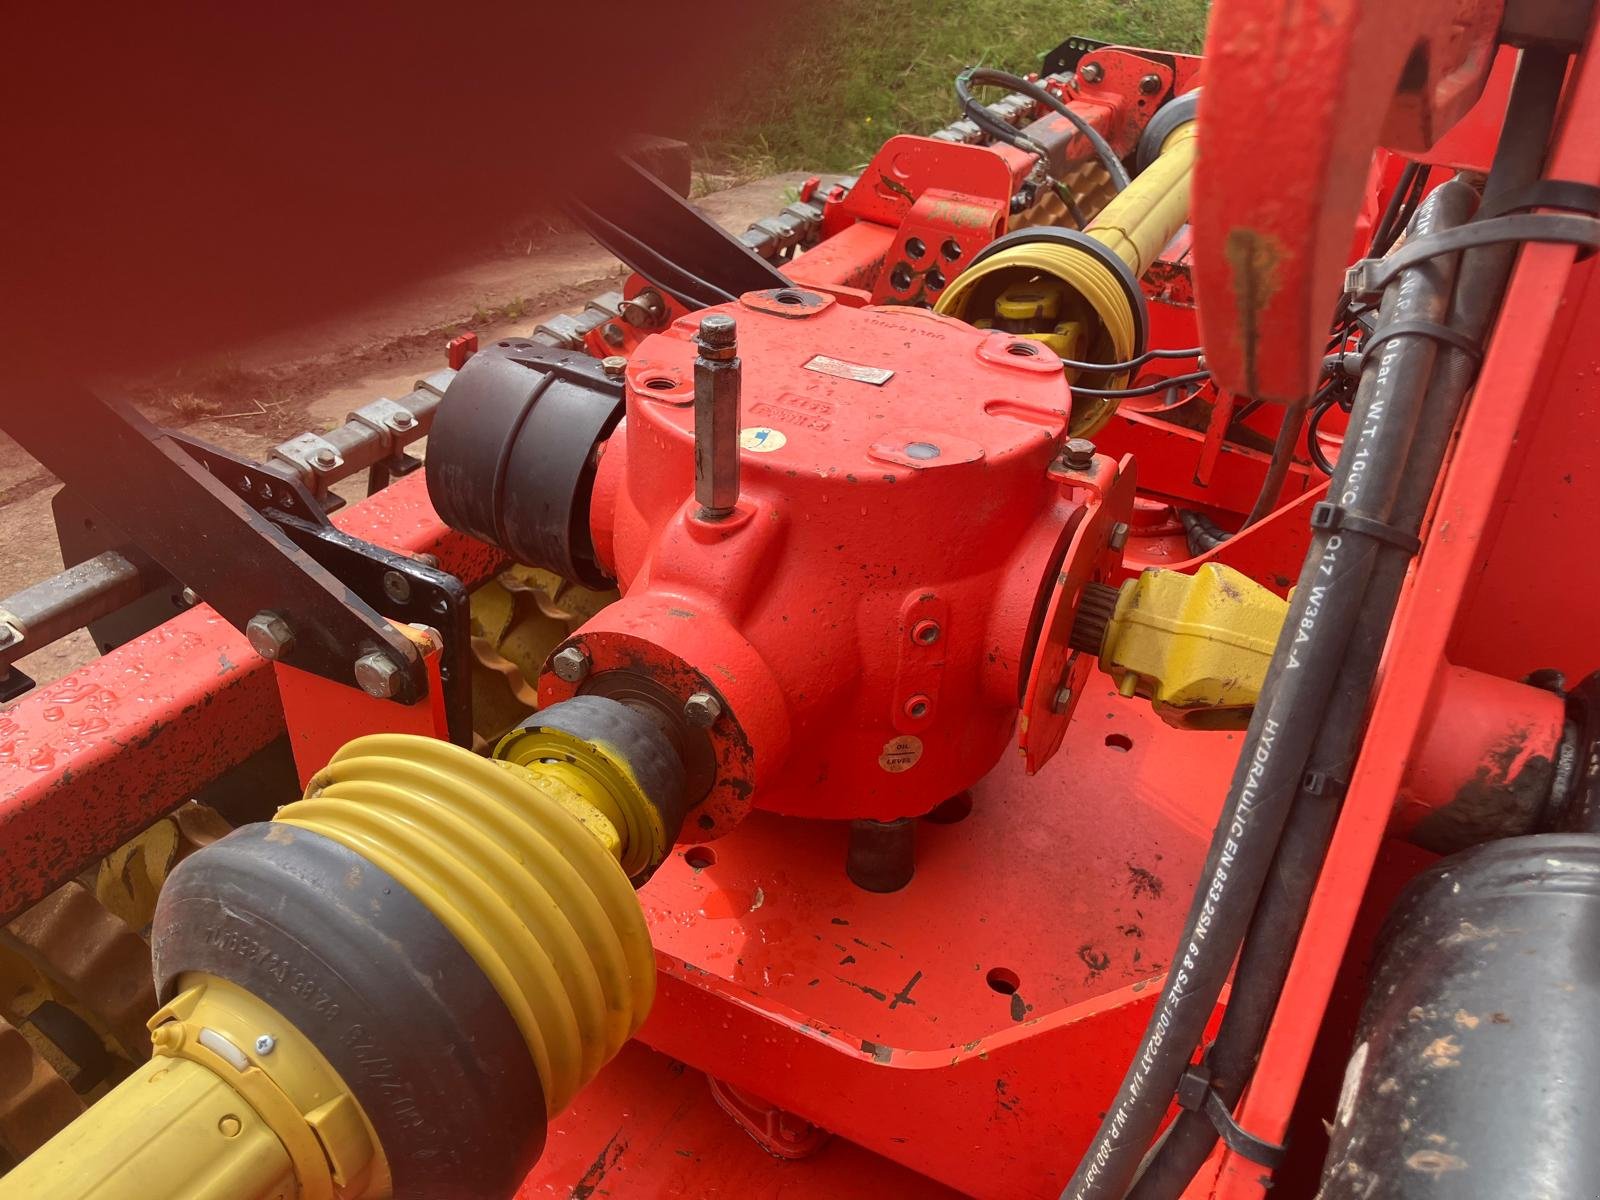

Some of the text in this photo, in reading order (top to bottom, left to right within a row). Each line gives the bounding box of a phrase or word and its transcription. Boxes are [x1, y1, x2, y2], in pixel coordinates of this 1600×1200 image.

[1376, 353, 1397, 385] bar
[1360, 400, 1385, 442] W.T.
[1342, 448, 1370, 504] 100°C
[1319, 535, 1342, 577] Q17
[886, 757, 911, 766] LEVEL
[1231, 718, 1280, 838] HYDRAULIC
[1220, 838, 1239, 869] EN
[1209, 866, 1229, 902] 853
[1194, 901, 1216, 940] 2SN
[1182, 953, 1195, 970] &
[1189, 941, 1200, 956] 6
[1168, 969, 1189, 1009] SAE
[1141, 1006, 1173, 1075] 100R2AT
[1108, 1107, 1129, 1139] W.P.
[1096, 1137, 1113, 1167] 400
[1086, 1163, 1101, 1189] bar
